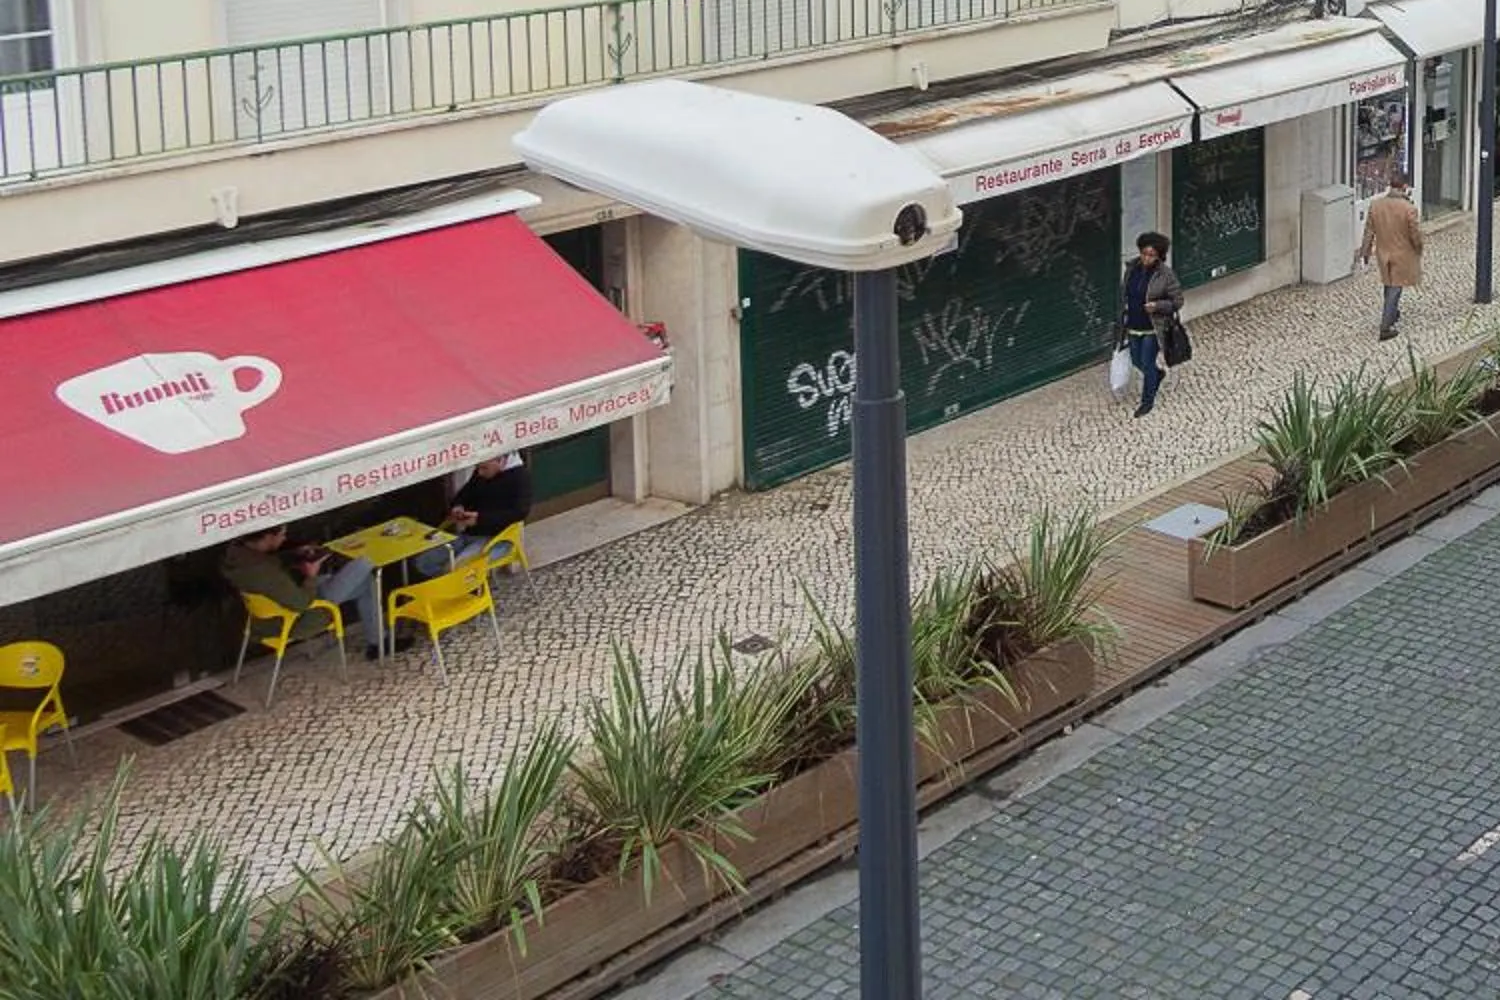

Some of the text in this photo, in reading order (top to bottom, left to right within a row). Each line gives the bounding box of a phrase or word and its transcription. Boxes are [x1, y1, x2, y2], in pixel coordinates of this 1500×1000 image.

[975, 157, 1063, 192] Restaurante
[1071, 148, 1107, 168] Serra
[1115, 139, 1131, 156] da
[200, 486, 324, 535] Pastelaria
[337, 442, 471, 494] Restaurante
[515, 415, 559, 440] Bela
